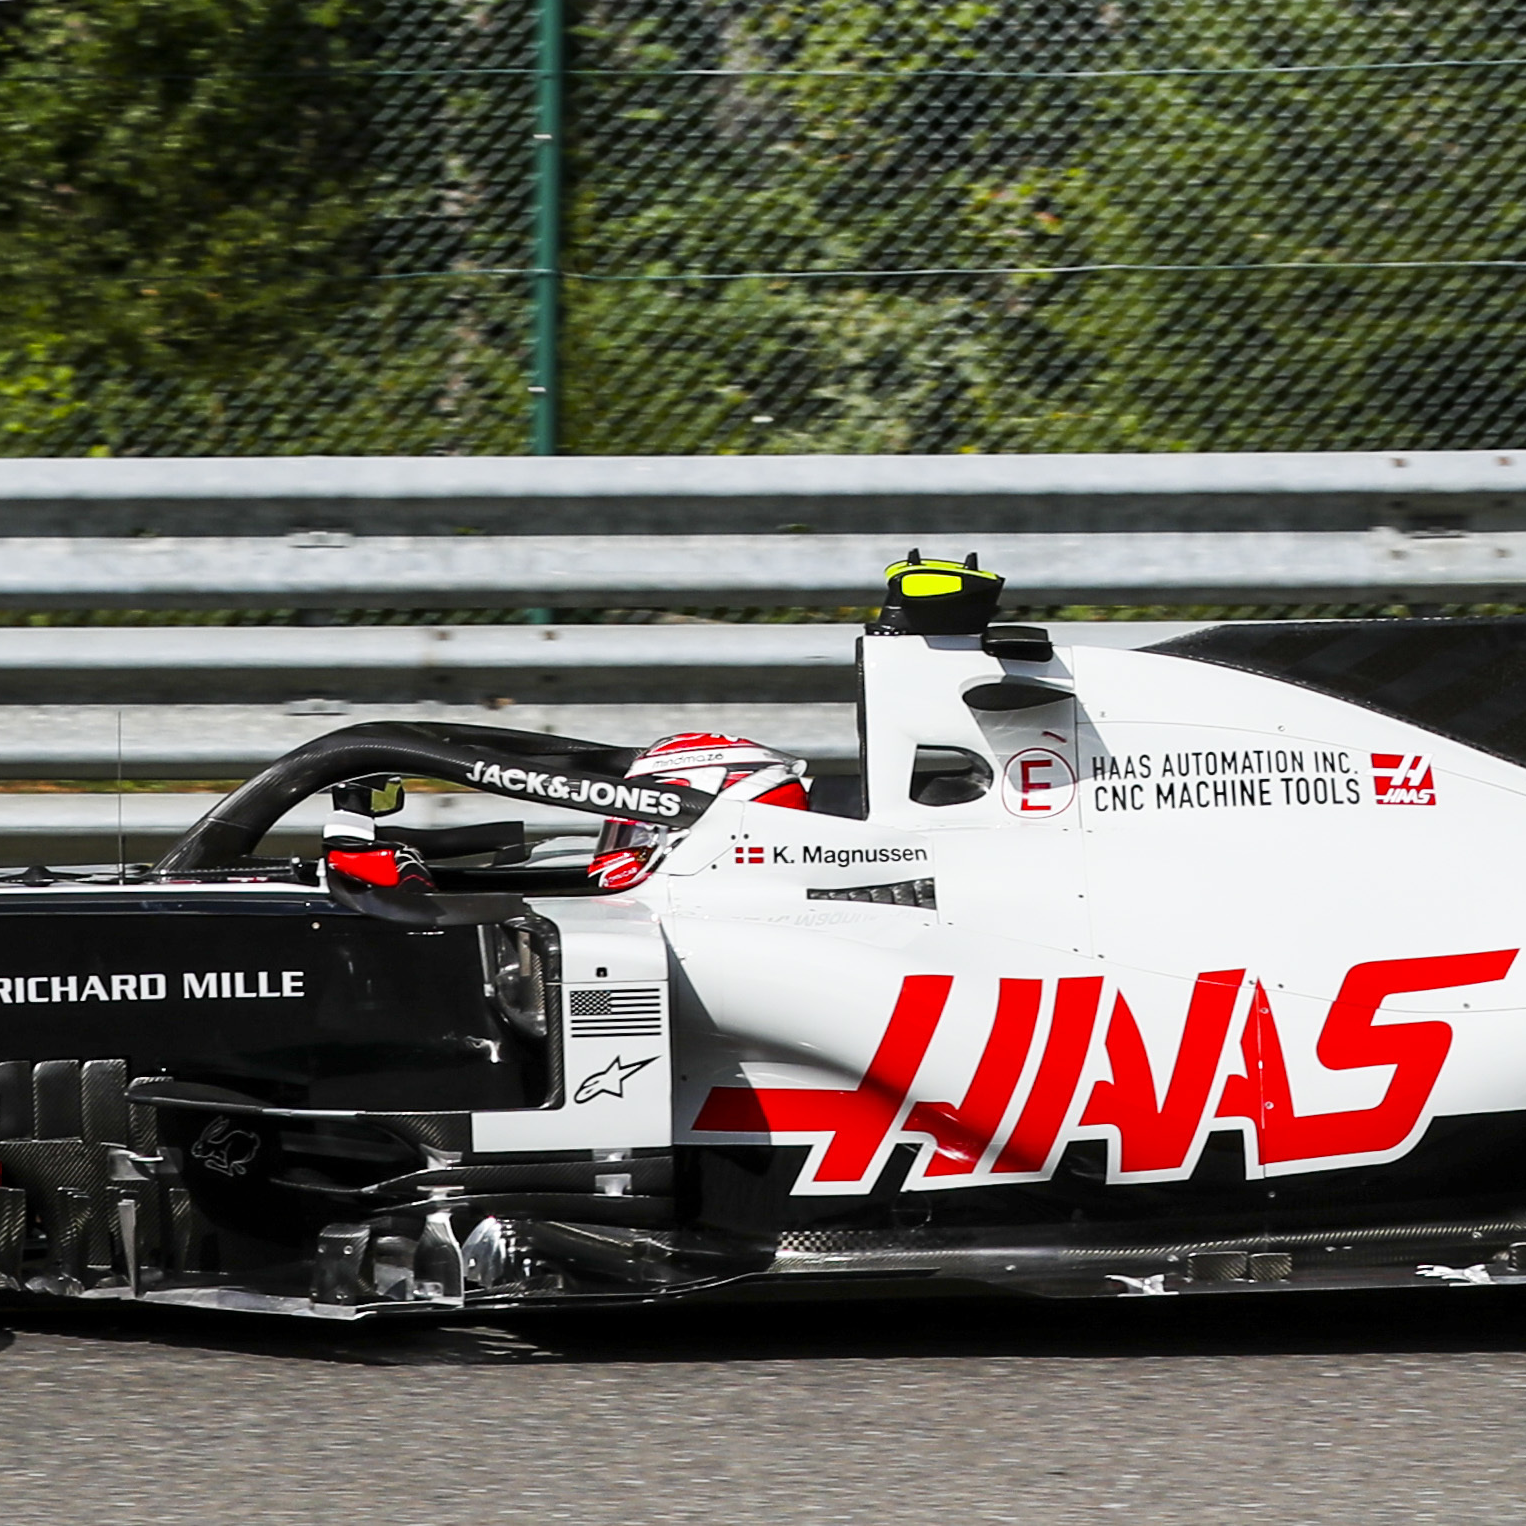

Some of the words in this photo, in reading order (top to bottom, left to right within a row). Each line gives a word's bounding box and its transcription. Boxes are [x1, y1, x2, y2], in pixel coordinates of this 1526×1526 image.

[652, 753, 724, 769] mindmaze
[1092, 754, 1152, 782] HAAS
[1161, 750, 1305, 777] AUTOMATION
[1313, 750, 1359, 775] INC.
[465, 760, 682, 817] JACK&JONES
[1020, 759, 1053, 811] E
[1094, 785, 1145, 812] CNC
[1156, 779, 1272, 809] MACHINE
[1280, 777, 1361, 806] TOOLS
[1373, 788, 1436, 804] HAAS
[773, 846, 795, 864] K.
[803, 845, 928, 867] Magnussen
[182, 970, 306, 999] MILLE
[691, 948, 1520, 1184] HAAS
